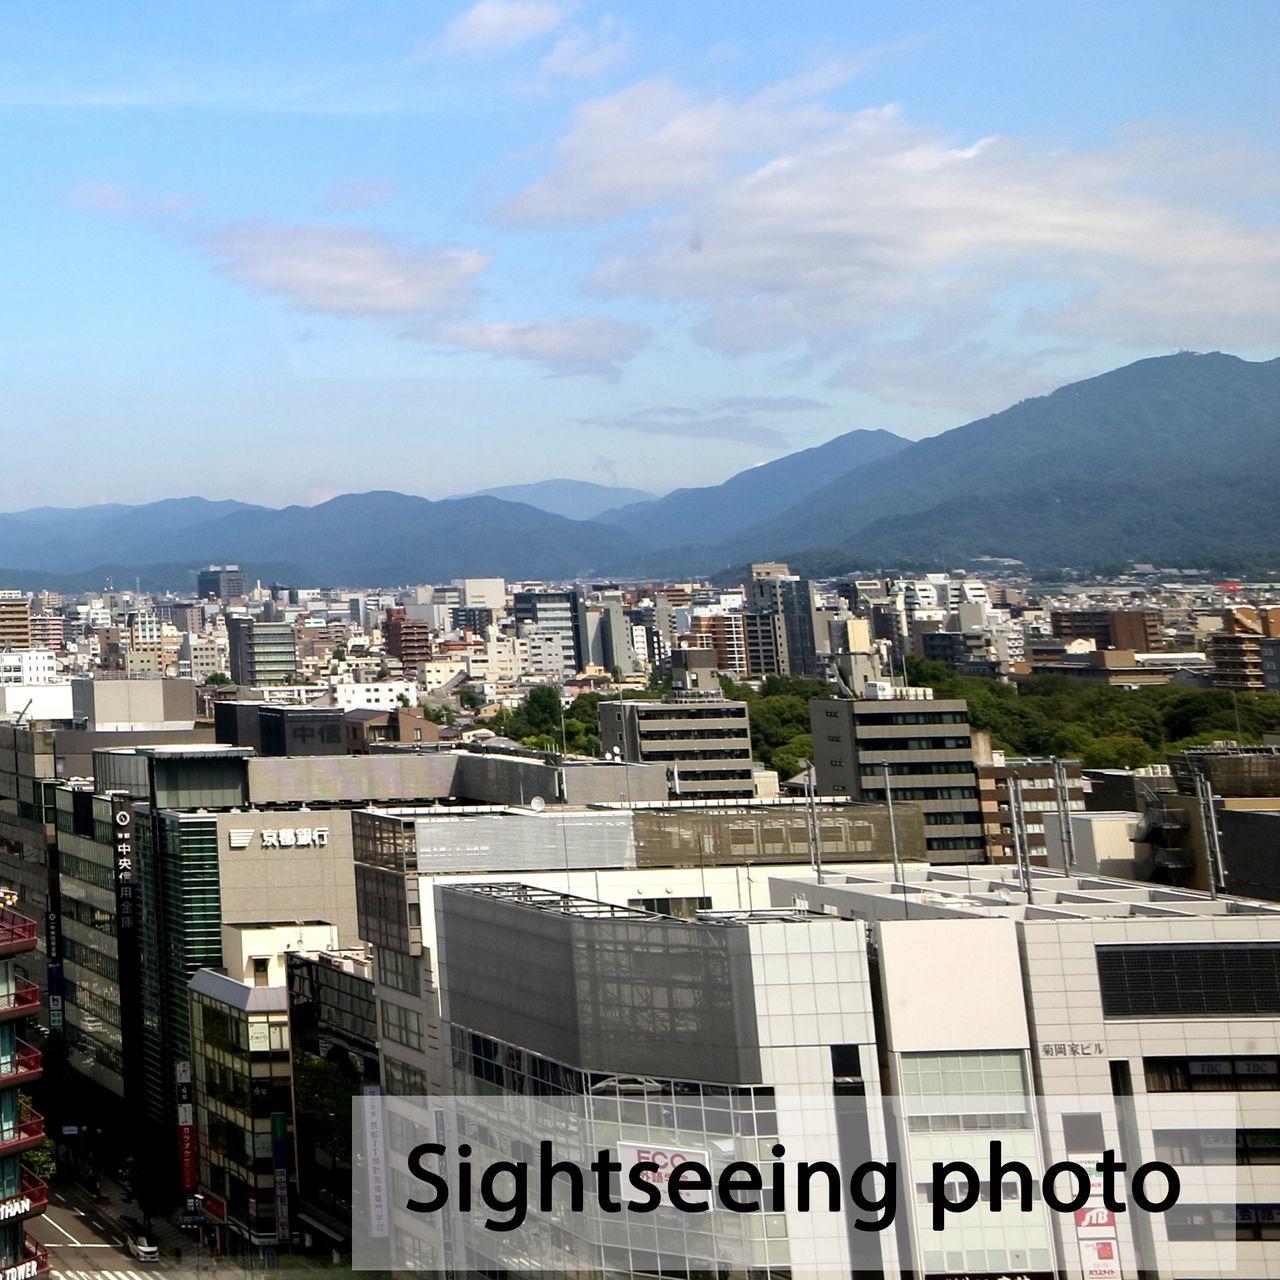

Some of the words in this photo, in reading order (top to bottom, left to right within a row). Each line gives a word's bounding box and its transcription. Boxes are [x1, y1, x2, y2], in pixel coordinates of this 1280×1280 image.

[292, 723, 342, 744] 中信
[261, 827, 329, 848] 京都銀行
[1041, 1043, 1105, 1057] 菊岡家ビル
